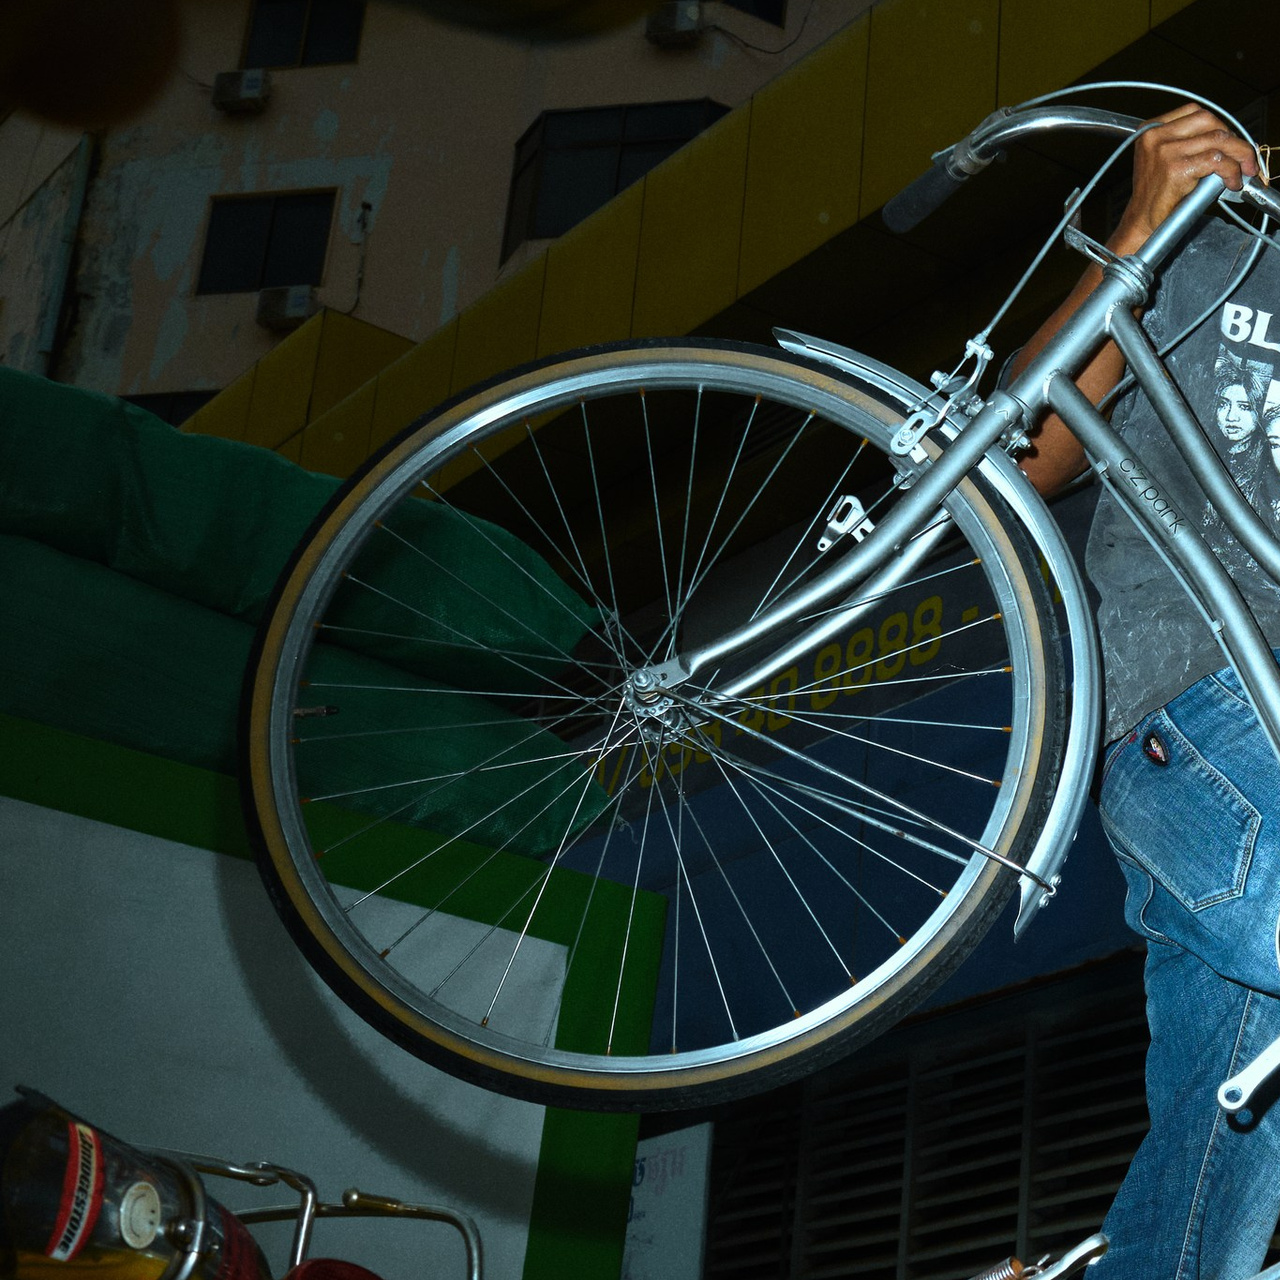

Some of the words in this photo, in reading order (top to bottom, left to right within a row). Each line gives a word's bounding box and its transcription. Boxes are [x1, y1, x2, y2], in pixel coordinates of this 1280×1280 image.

[1139, 485, 1186, 534] park
[811, 595, 943, 710] 8888
[58, 1130, 94, 1253] BRIDGESTONE
